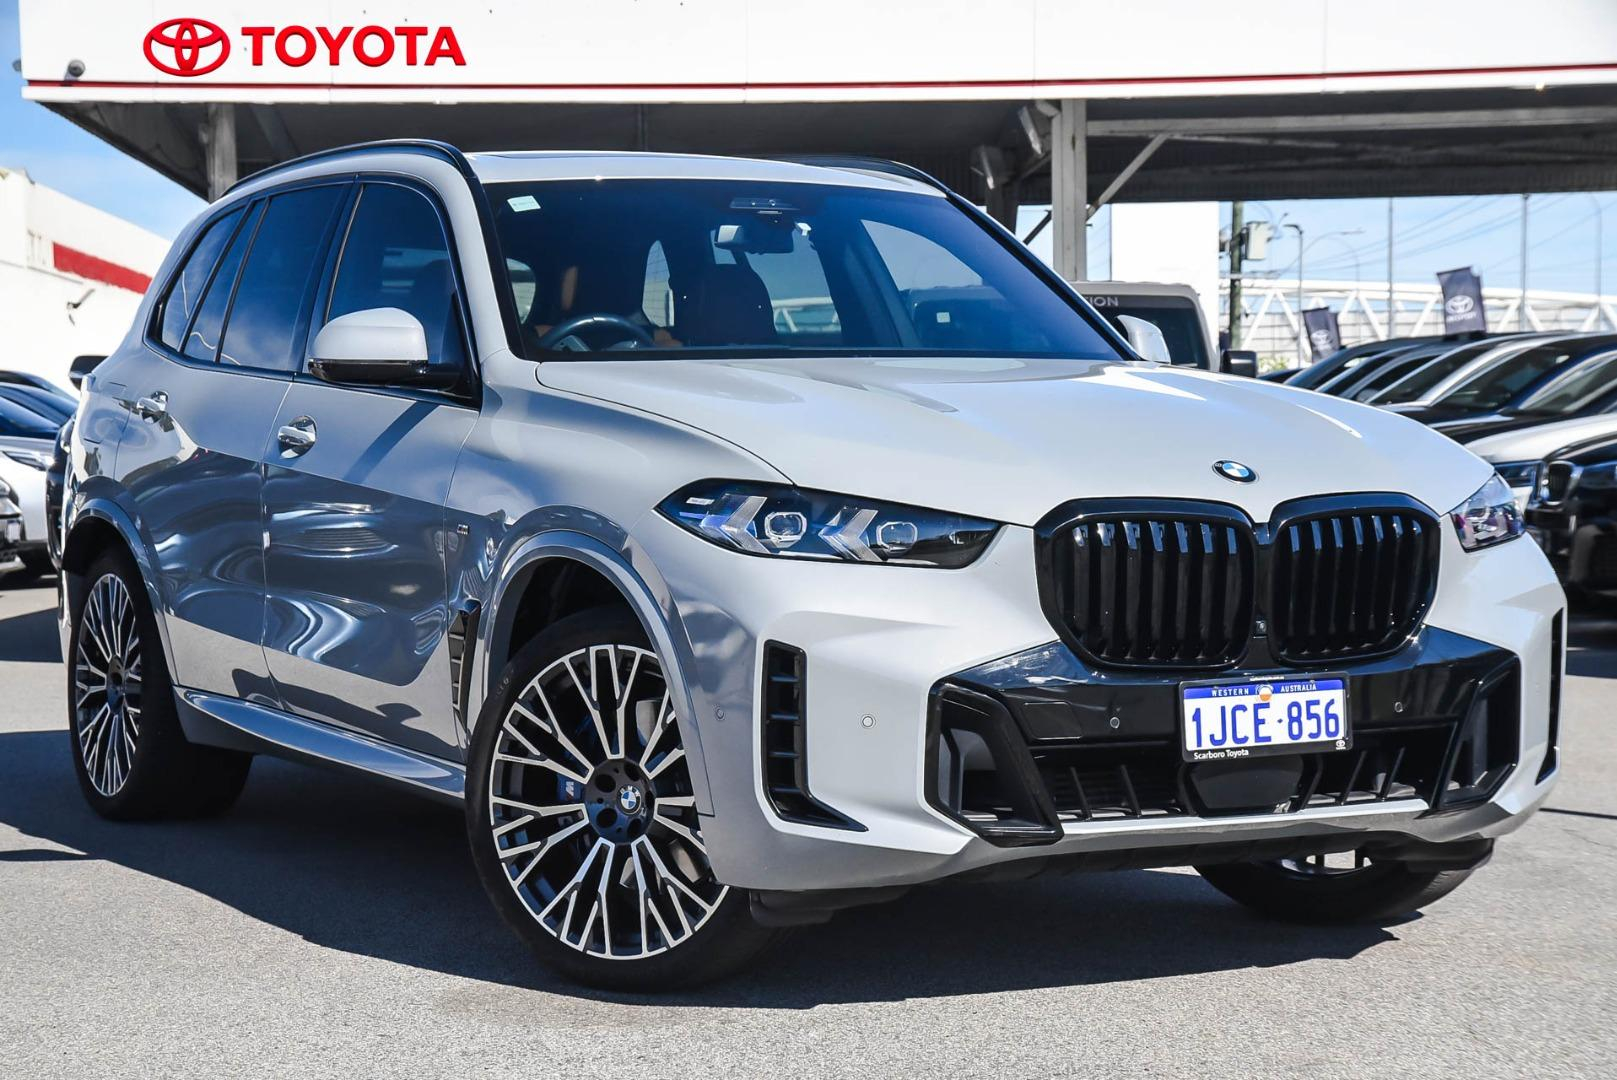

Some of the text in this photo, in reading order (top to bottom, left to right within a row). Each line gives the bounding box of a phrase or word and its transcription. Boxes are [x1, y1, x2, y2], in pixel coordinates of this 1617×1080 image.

[241, 25, 467, 67] TOYOTA
[1211, 683, 1317, 697] WESTERN AUSTRALIA
[1193, 749, 1249, 760] Scarboro Toyota
